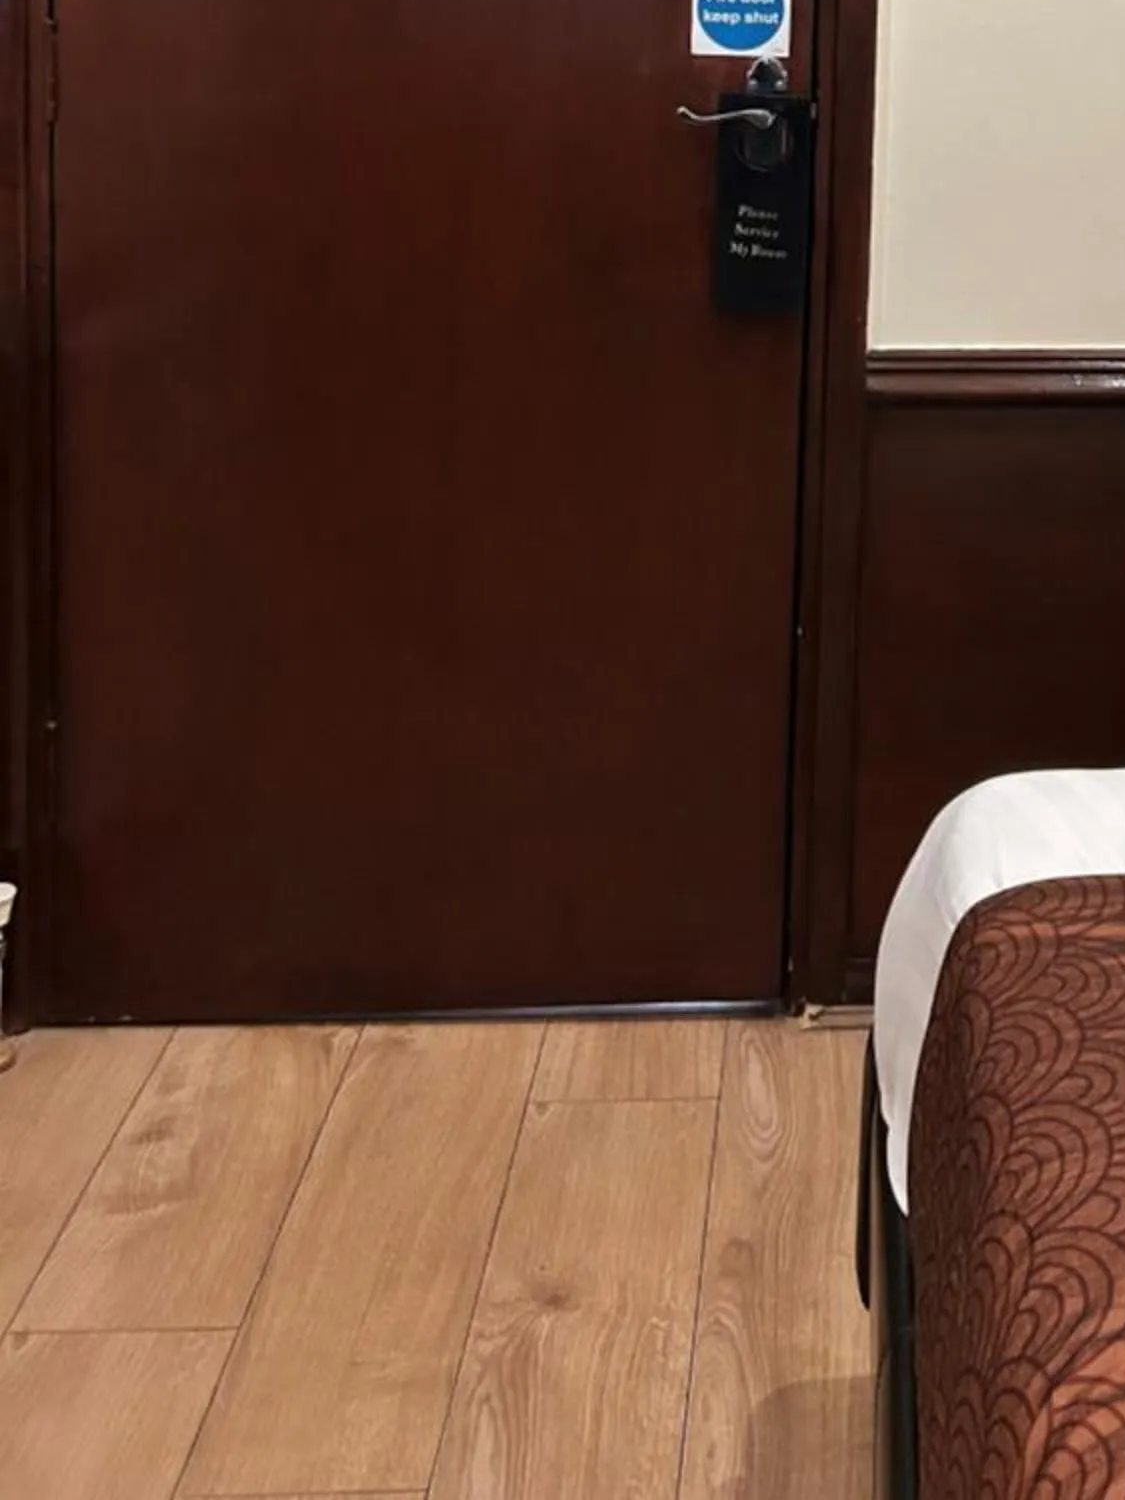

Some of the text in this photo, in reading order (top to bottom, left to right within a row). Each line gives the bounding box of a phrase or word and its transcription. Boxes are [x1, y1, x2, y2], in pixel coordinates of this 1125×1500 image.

[703, 9, 779, 26] keep shut
[730, 241, 787, 259] My Room
